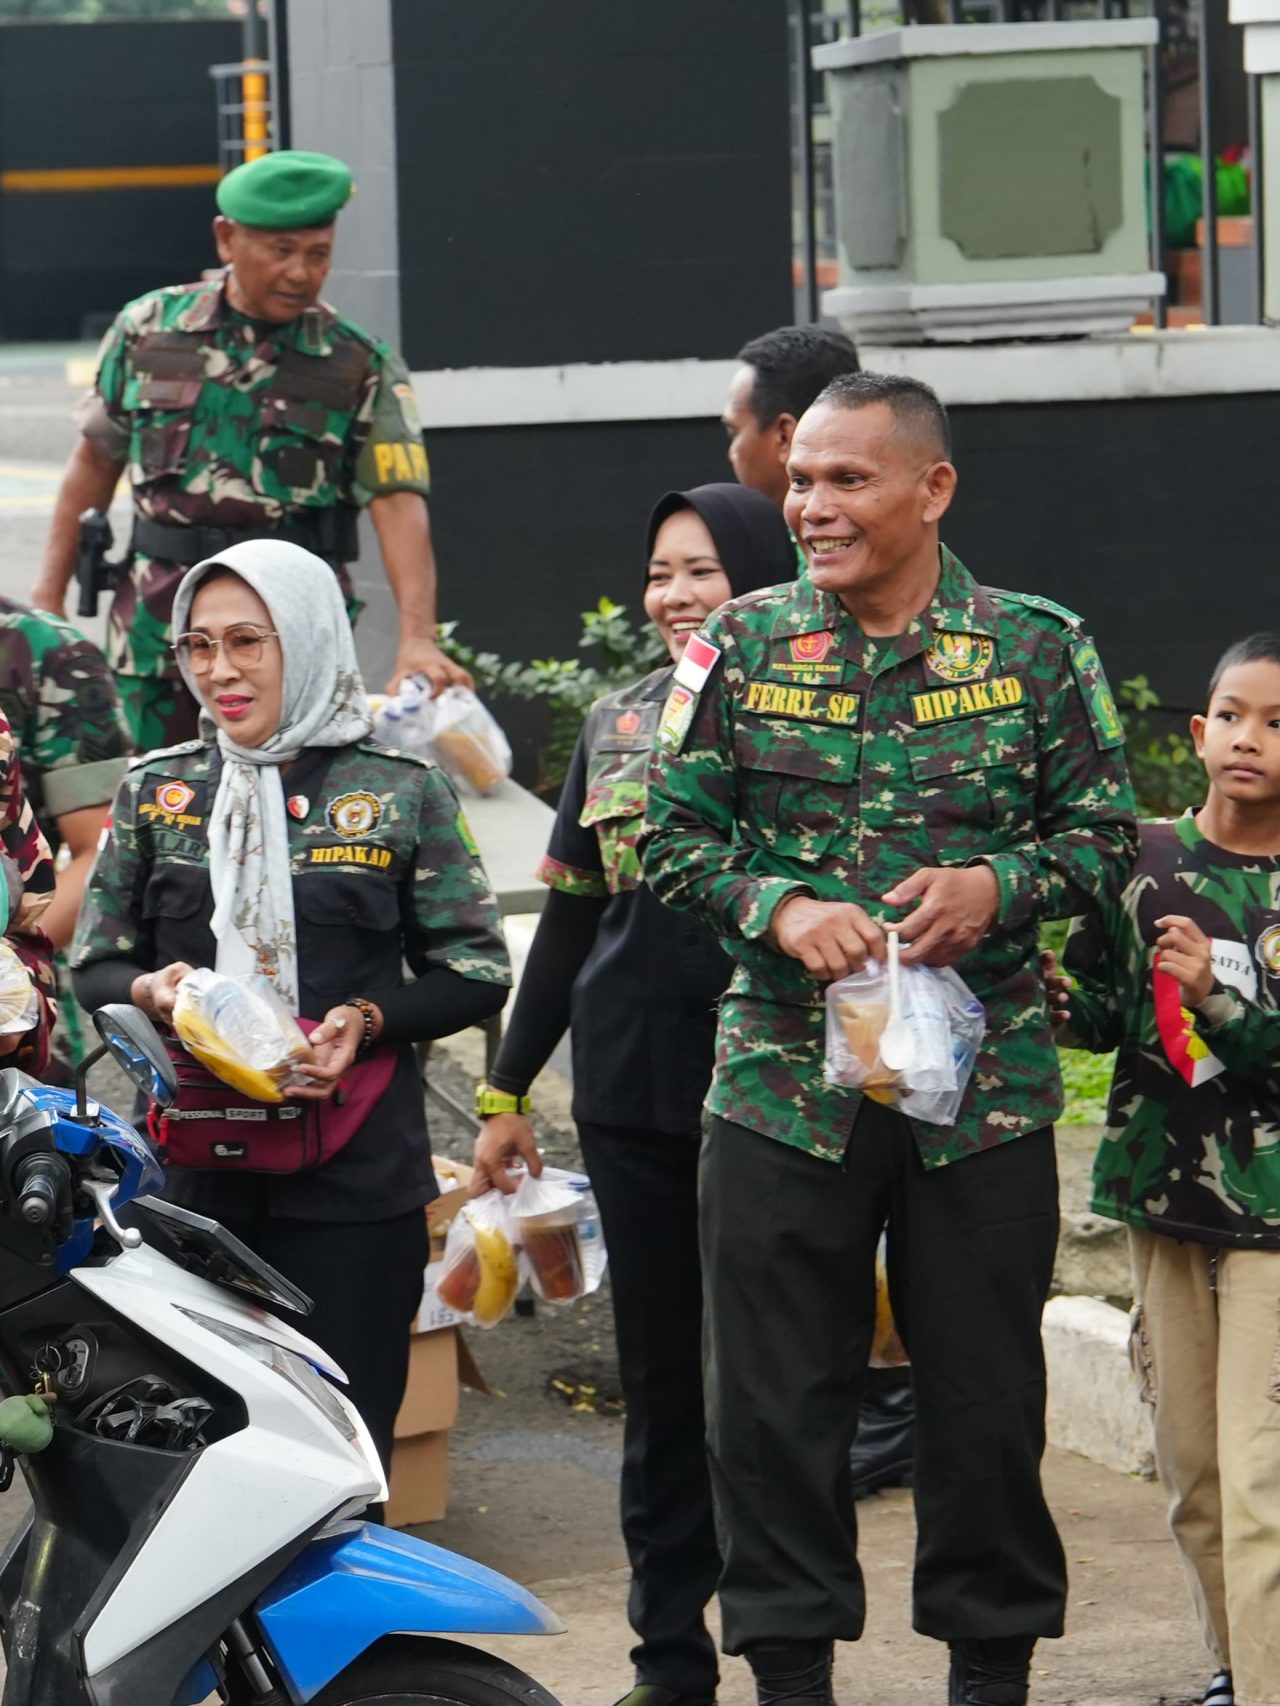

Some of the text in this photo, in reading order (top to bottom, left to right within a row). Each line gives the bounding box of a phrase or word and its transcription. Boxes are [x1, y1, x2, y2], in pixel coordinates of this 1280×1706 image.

[826, 693, 857, 721] SP
[912, 676, 1022, 722] HIPAKAD
[310, 845, 392, 868] HIPAKAD
[228, 1109, 265, 1120] SPORT
